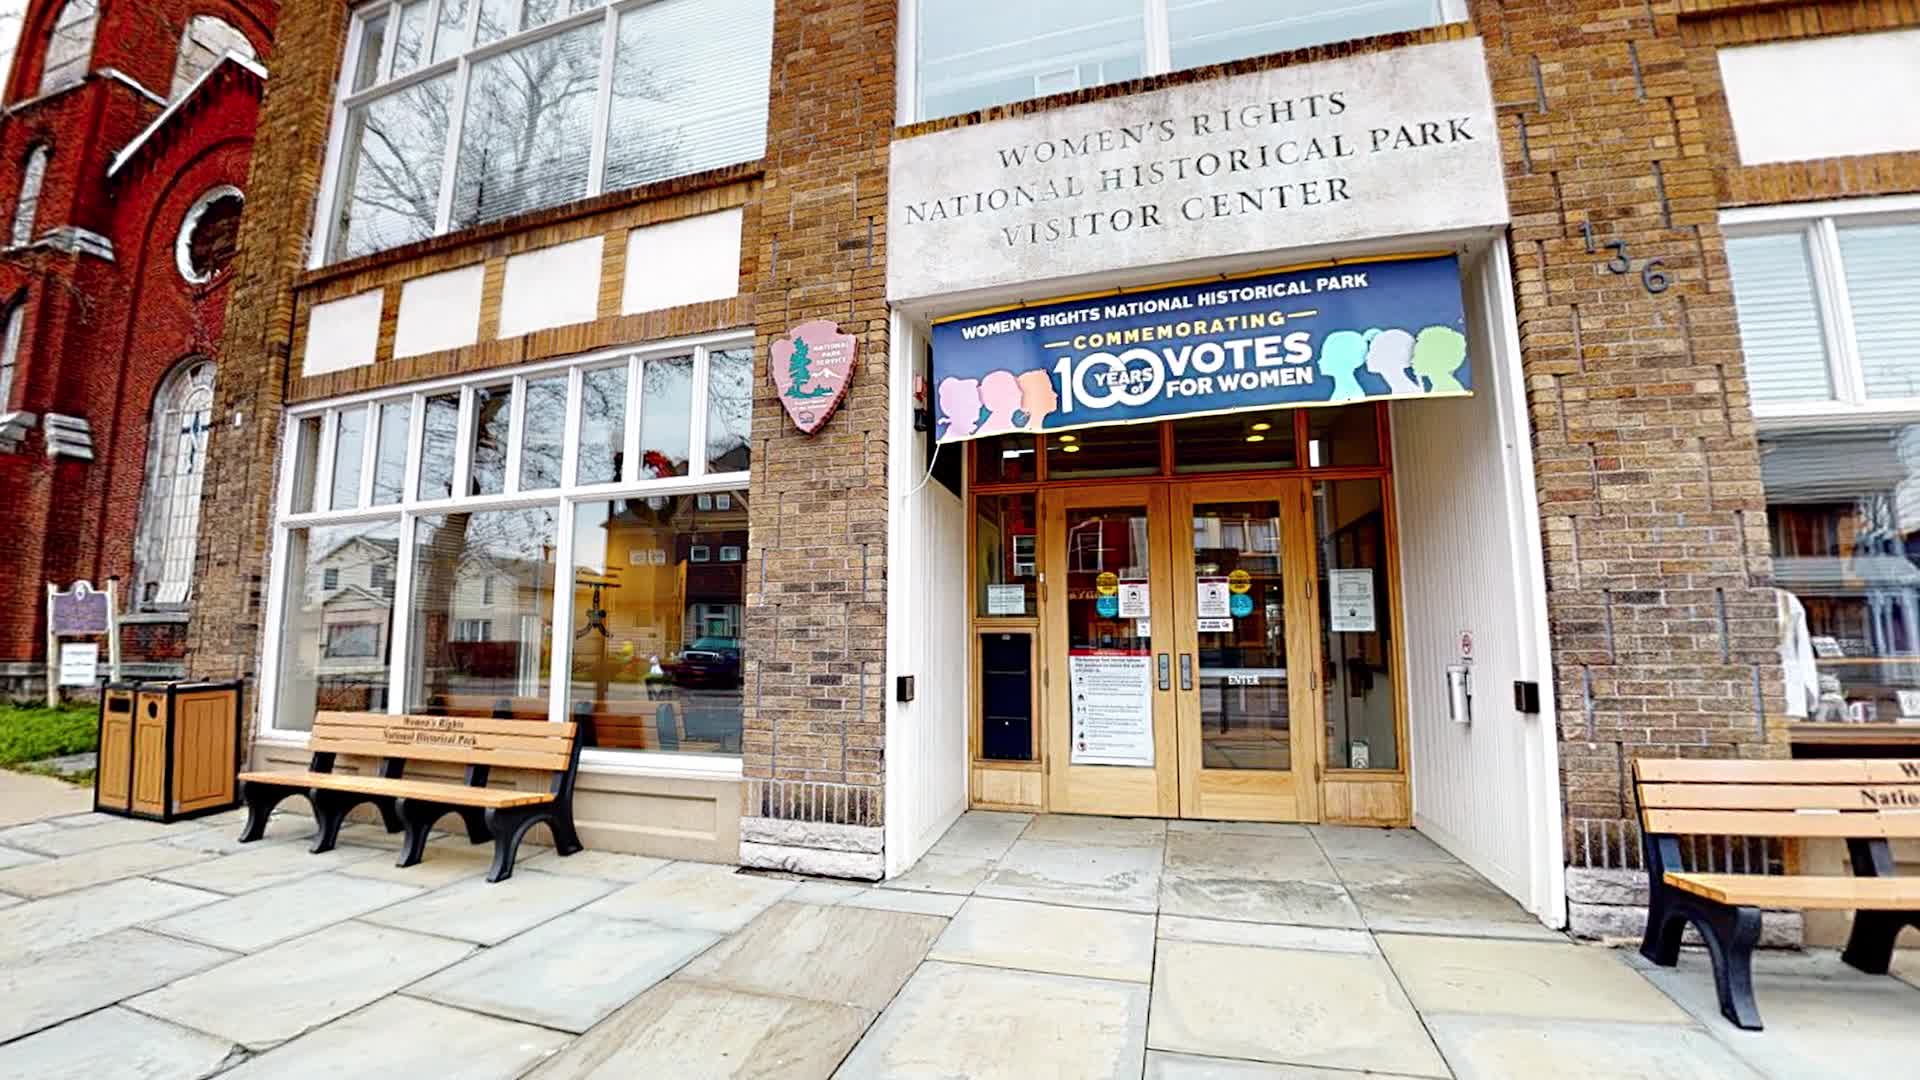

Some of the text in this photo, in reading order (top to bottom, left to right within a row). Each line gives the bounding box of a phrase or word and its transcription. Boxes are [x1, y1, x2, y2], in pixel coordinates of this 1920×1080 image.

[998, 91, 1347, 168] WOMEN'S RIGHTS
[904, 117, 1475, 225] NATIONAL HISTORICAL PARK
[1002, 177, 1351, 247] VISITOR CENTER
[1578, 221, 1670, 293] 136
[961, 273, 1368, 341] WOMEN'S RIGHTS NATIONAL HISTORICAL PARK
[1073, 311, 1286, 350] COMMEMORATING
[1053, 348, 1166, 414] 100
[1094, 366, 1154, 388] YEARS
[1162, 331, 1313, 377] VOTES
[1130, 382, 1145, 395] of
[1165, 366, 1314, 399] FOR WOMEN
[1227, 674, 1261, 686] ENTER
